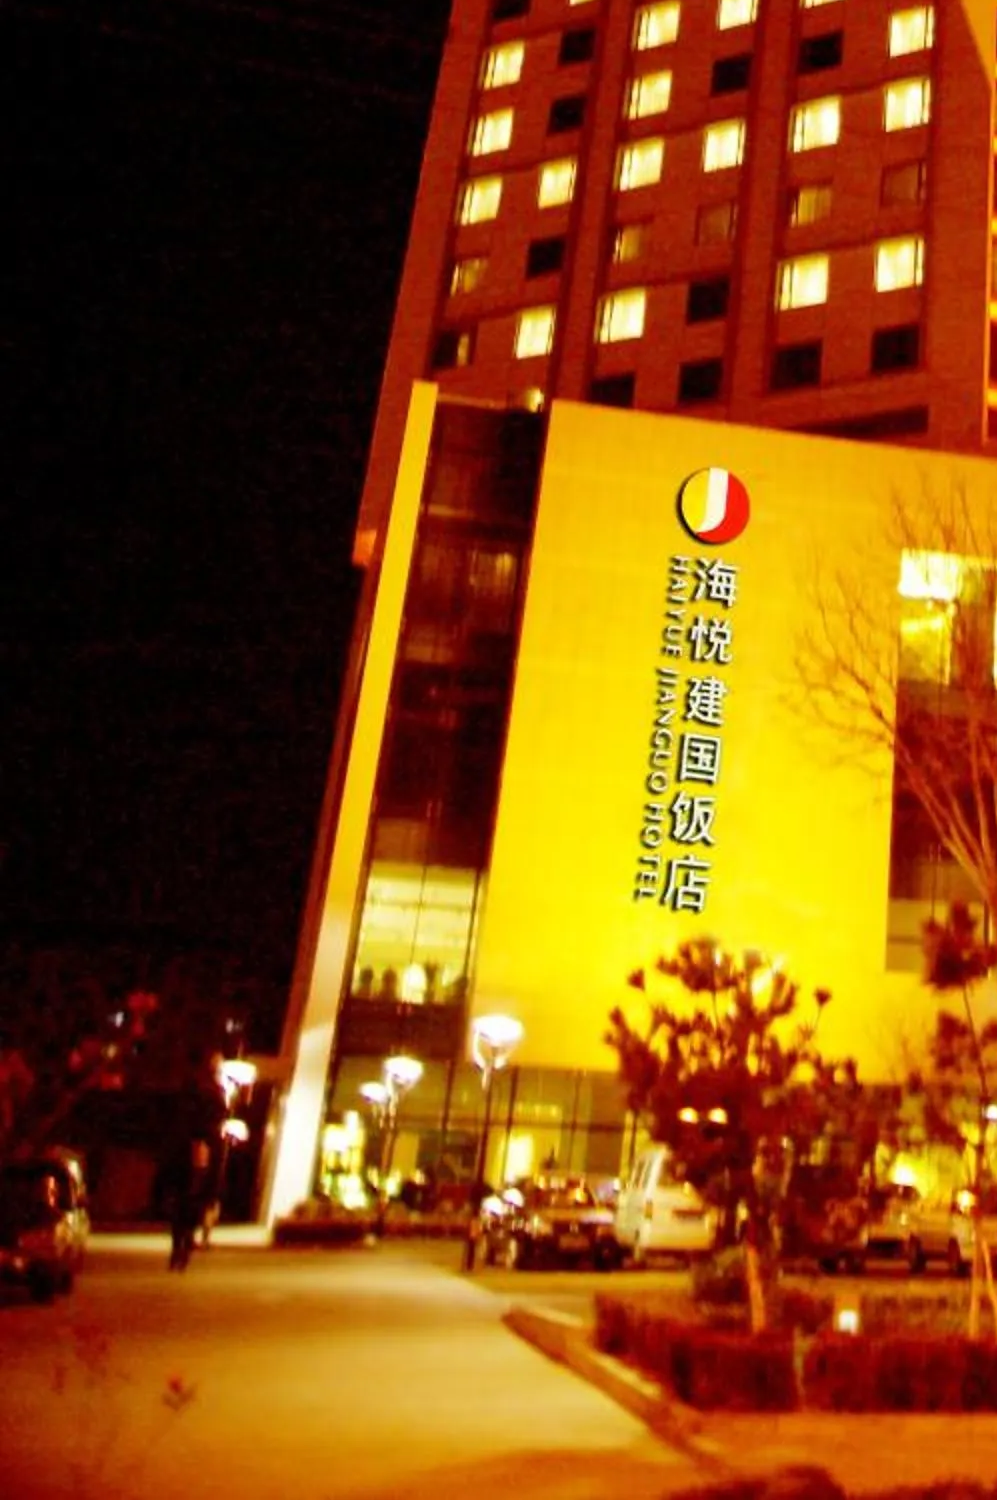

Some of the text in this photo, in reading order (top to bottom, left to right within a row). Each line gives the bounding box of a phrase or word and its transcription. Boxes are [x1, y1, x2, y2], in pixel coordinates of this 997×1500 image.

[634, 555, 690, 899] HAIYUE JIANGUO HOTEL
[660, 556, 738, 913] 海悦建国饭店
